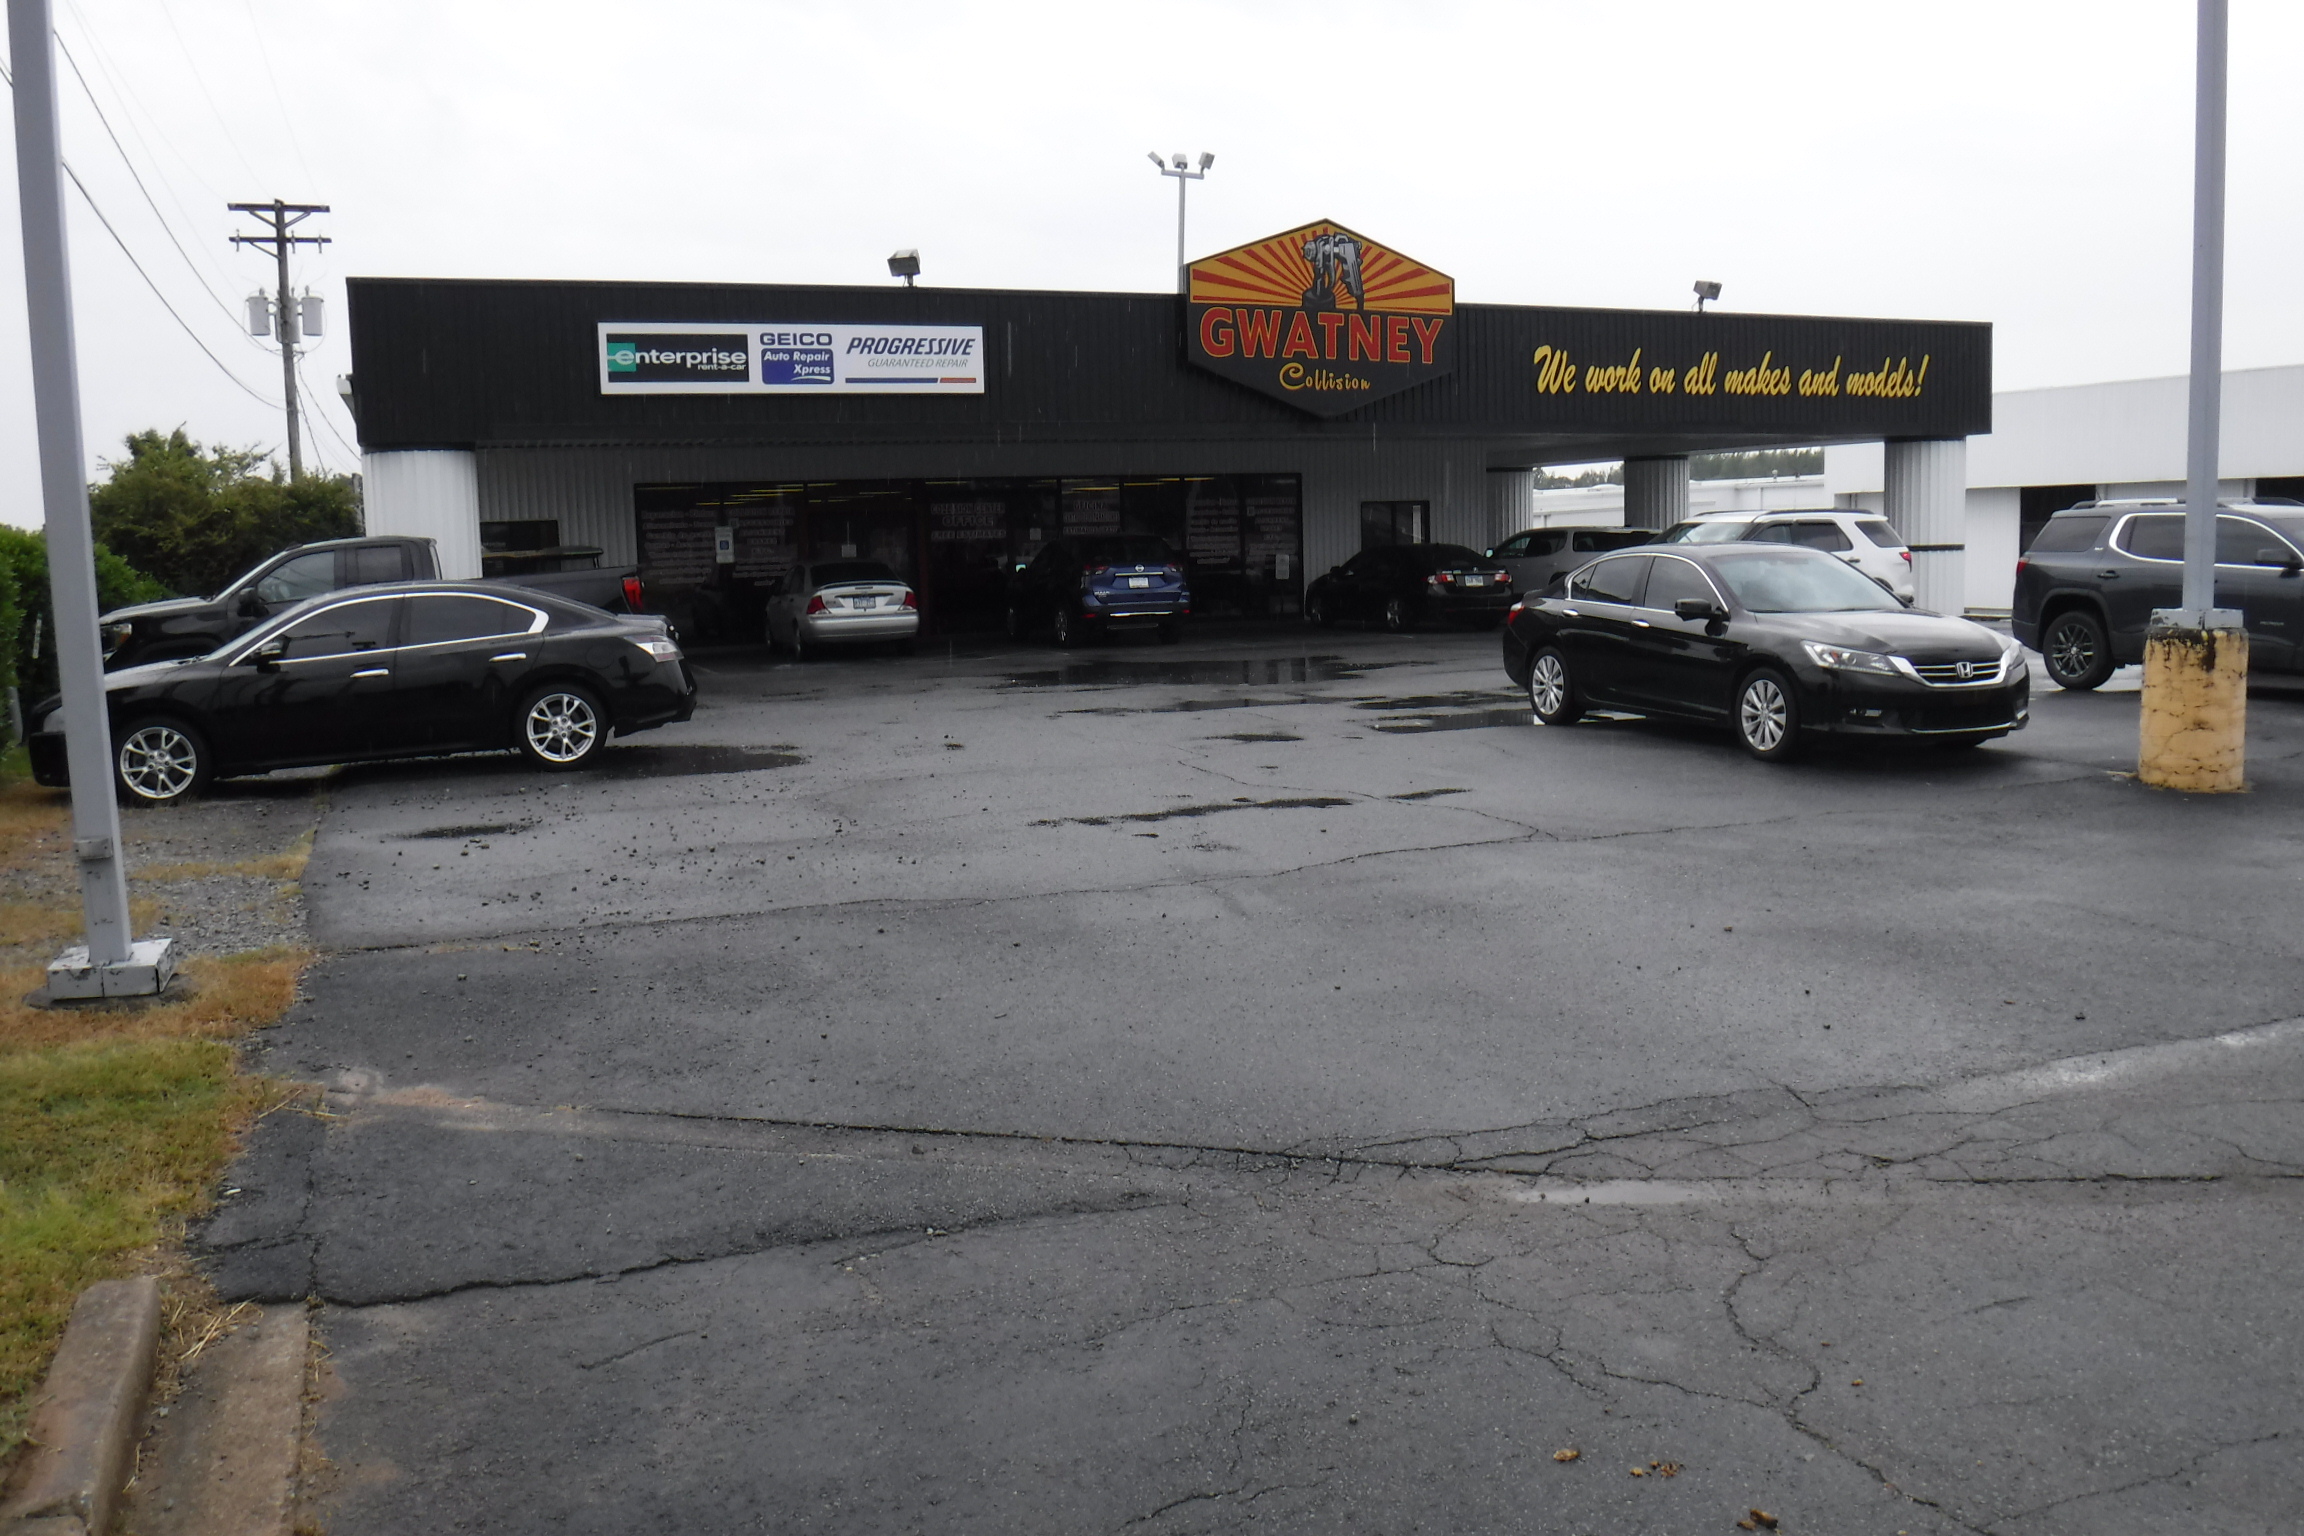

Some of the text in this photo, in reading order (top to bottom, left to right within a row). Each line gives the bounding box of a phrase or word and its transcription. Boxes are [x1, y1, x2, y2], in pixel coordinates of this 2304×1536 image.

[760, 333, 832, 346] GEICO
[1200, 307, 1443, 364] GWATNEY
[846, 337, 976, 355] PROGRESSIVE
[607, 348, 747, 368] enterprise
[763, 351, 830, 363] Auto Repair
[867, 358, 969, 368] GUARANTEED REPAIR
[793, 364, 831, 376] Xpress
[1279, 362, 1370, 391] Collision
[1534, 345, 1930, 397] We work on all makes and models!
[942, 515, 994, 527] OFFICE
